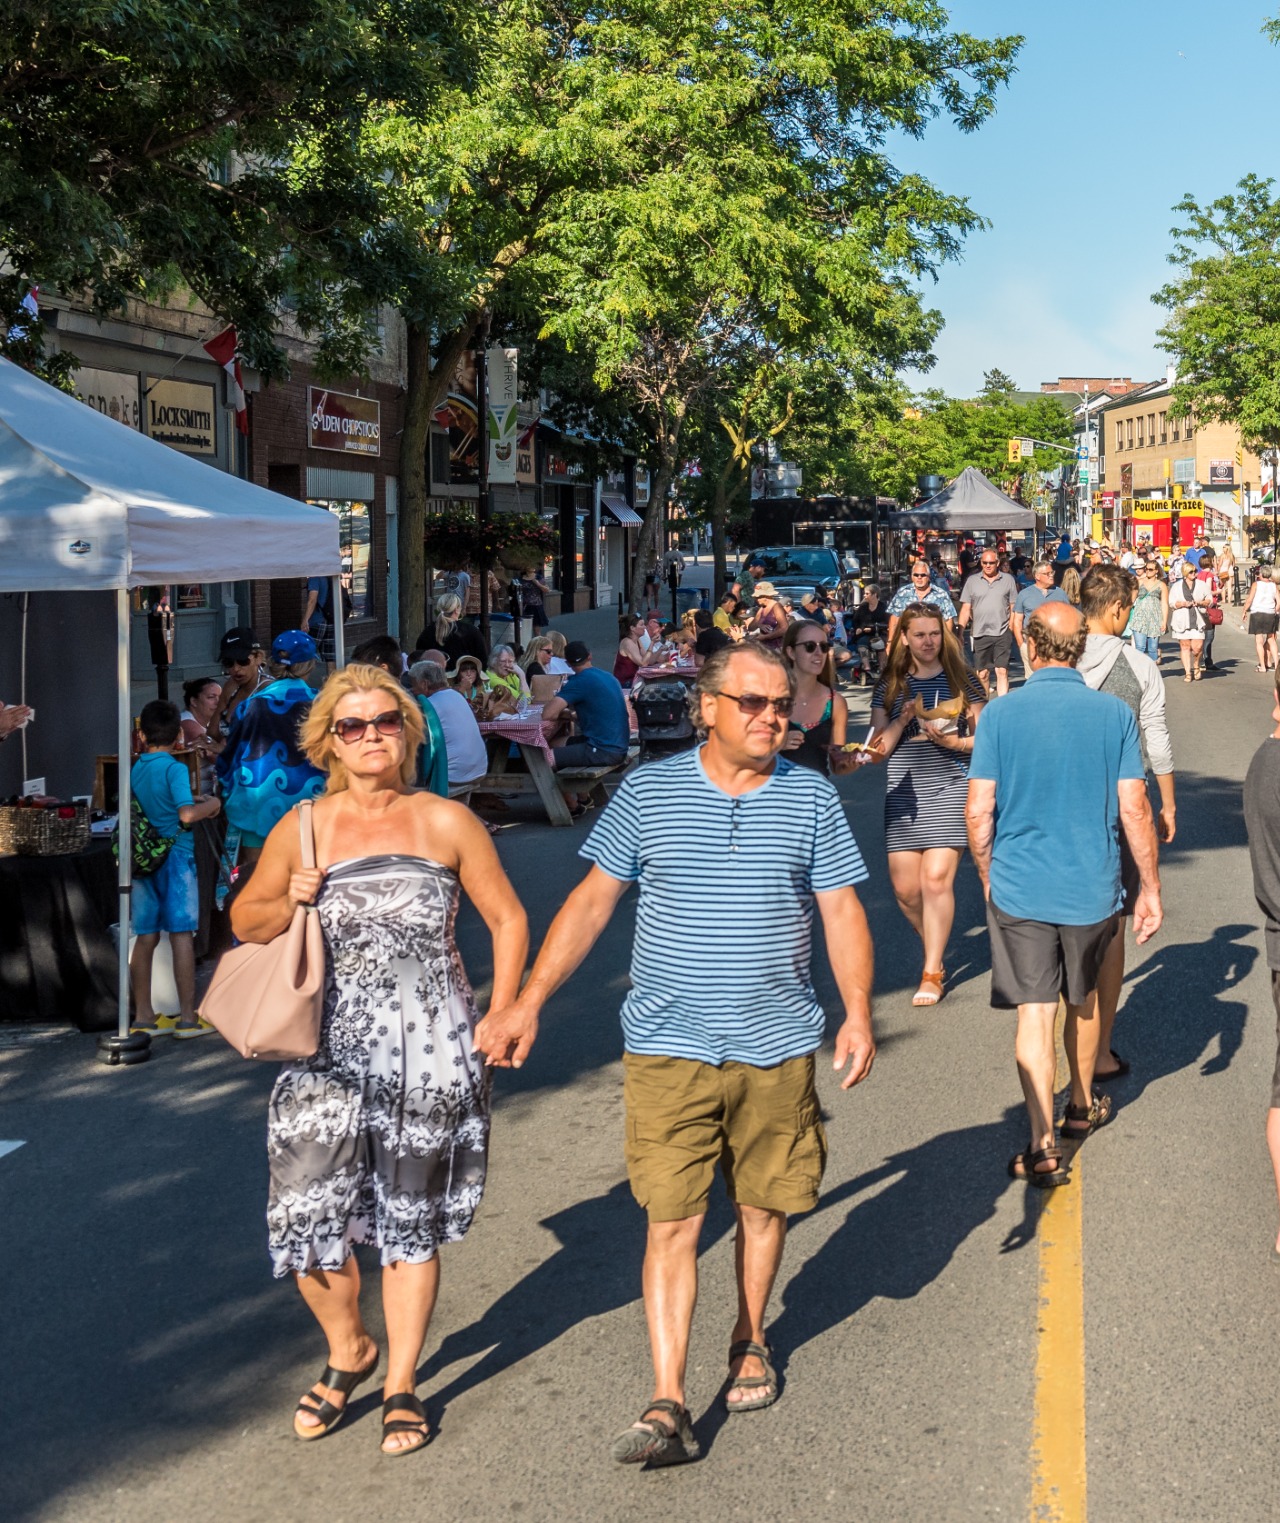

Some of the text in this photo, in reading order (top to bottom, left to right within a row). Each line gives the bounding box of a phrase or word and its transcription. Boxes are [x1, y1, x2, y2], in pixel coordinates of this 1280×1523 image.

[504, 358, 514, 400] THRIVE
[151, 400, 211, 431] LOCKSMITH
[312, 413, 380, 439] GOLDEN CHOPSTICKS
[1134, 500, 1202, 512] Poutine Krazee
